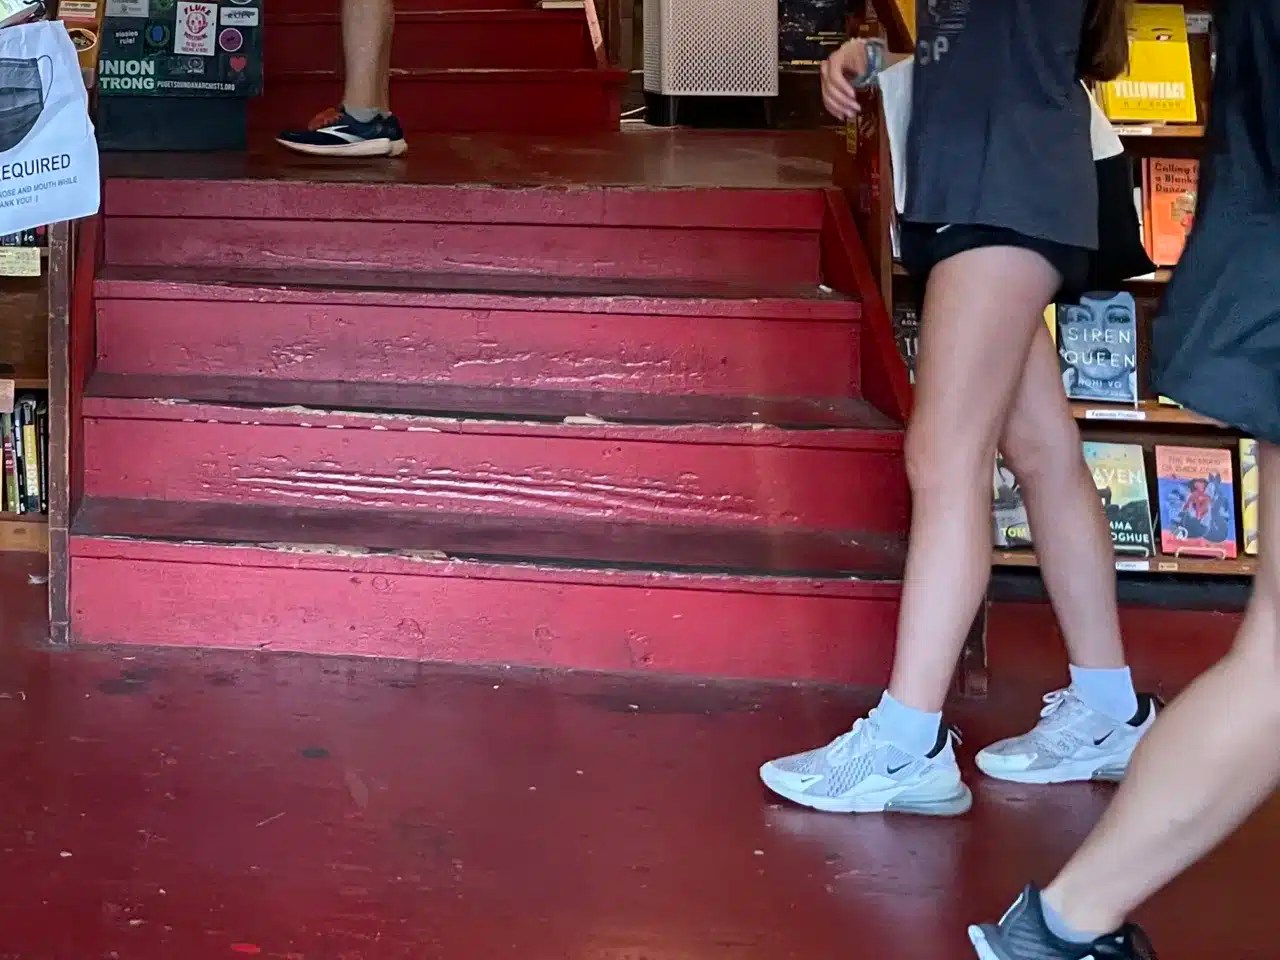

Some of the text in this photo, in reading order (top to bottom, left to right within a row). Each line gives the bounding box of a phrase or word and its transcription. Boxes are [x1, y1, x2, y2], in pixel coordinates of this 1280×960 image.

[184, 4, 212, 16] FLUKE
[100, 76, 155, 90] TRONG
[1155, 162, 1191, 174] Calling
[18, 185, 32, 195] AND
[33, 180, 57, 193] MOUTH
[1068, 327, 1132, 344] SIREN
[1064, 350, 1136, 368] QUEEN
[1002, 526, 1027, 538] TOM
